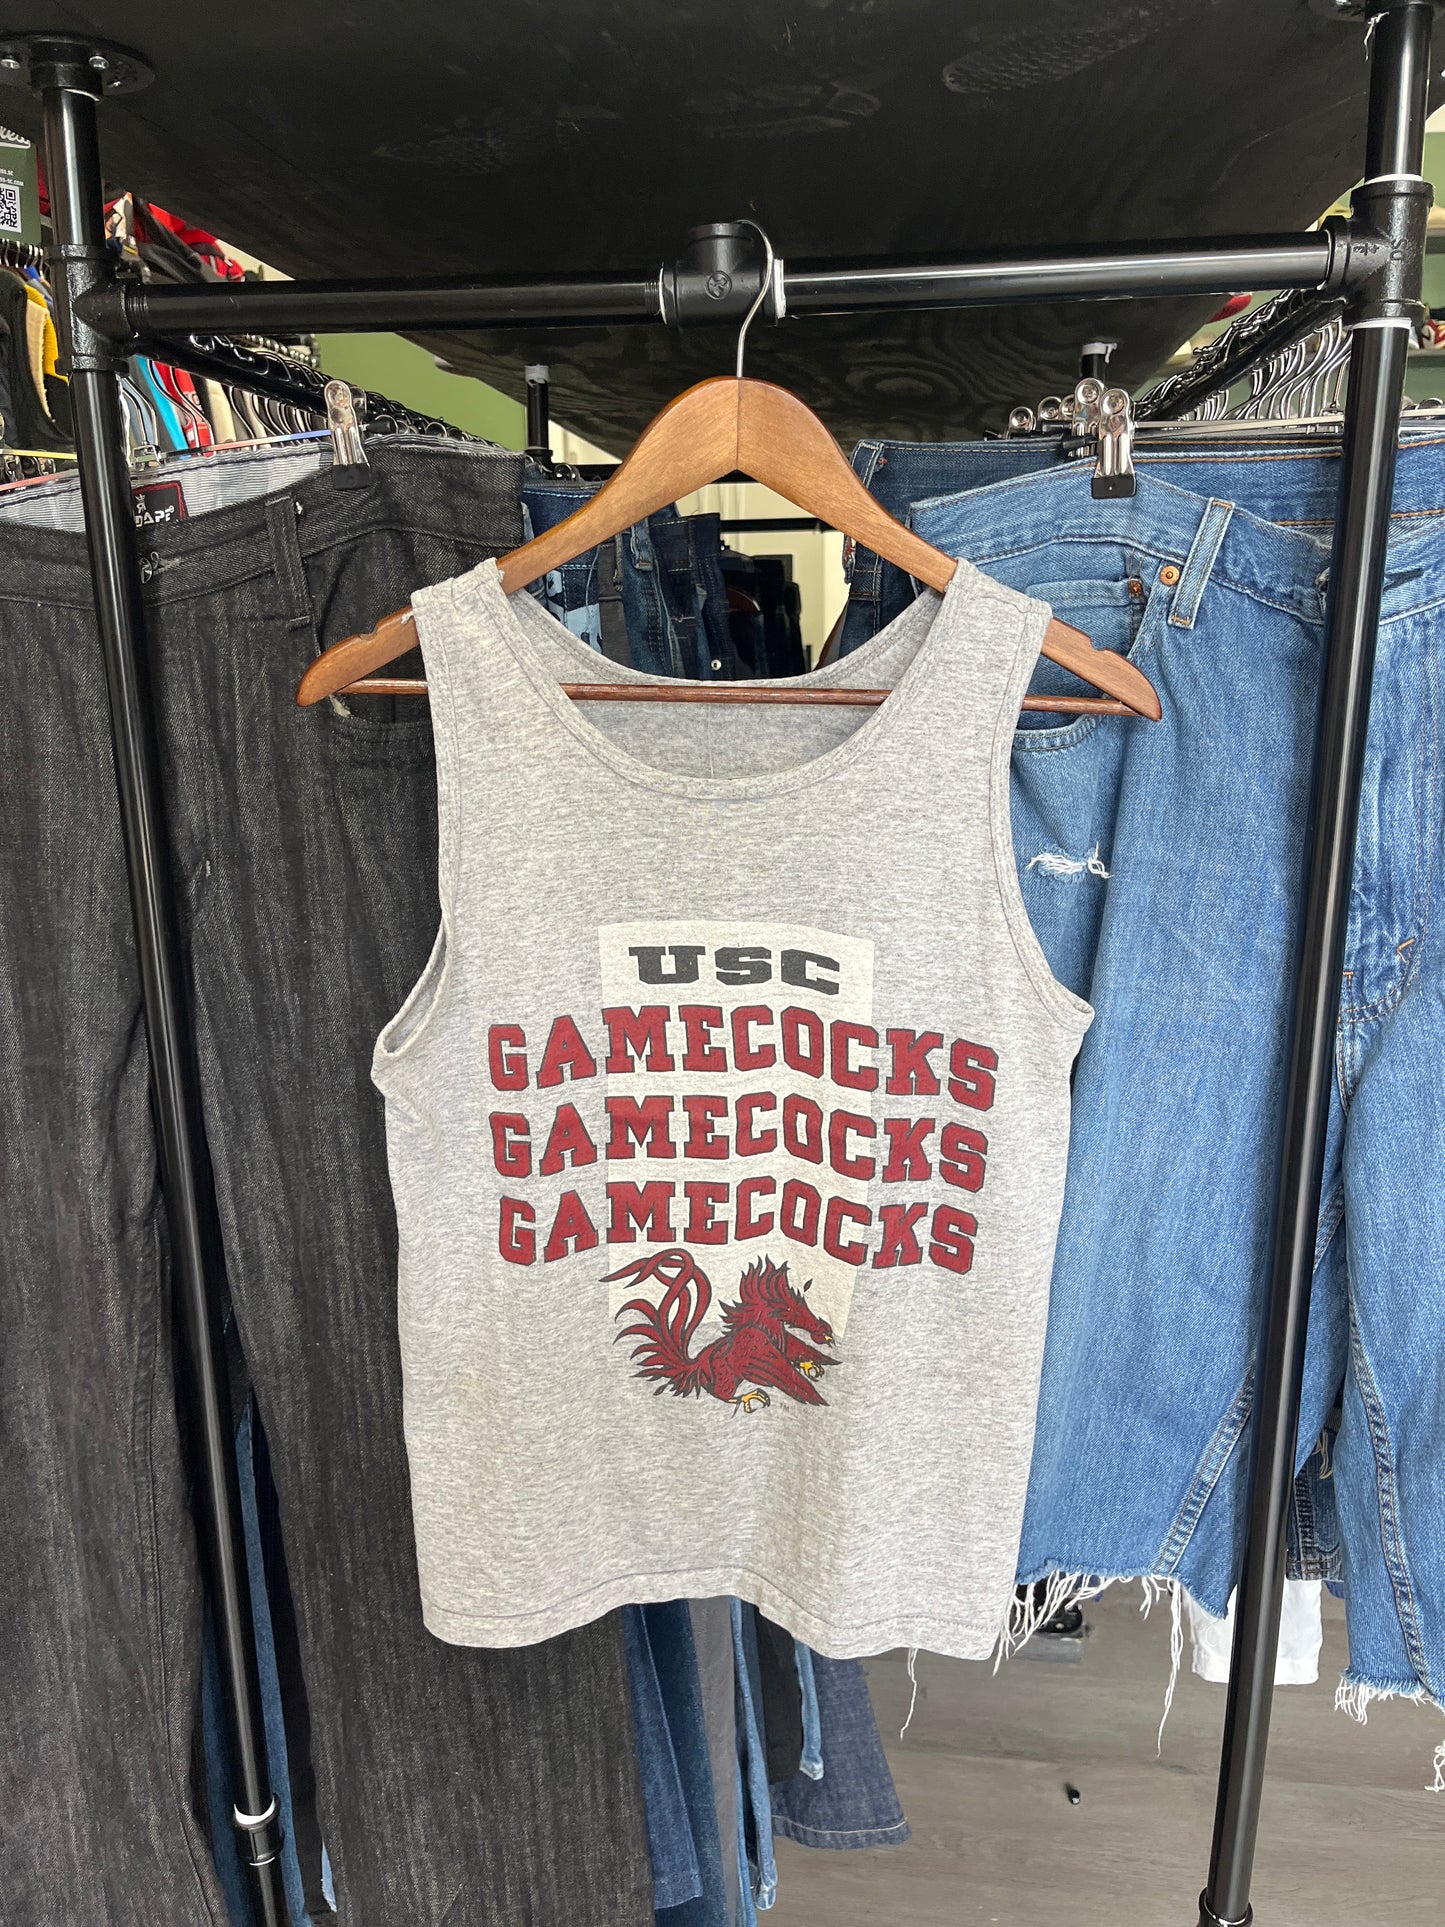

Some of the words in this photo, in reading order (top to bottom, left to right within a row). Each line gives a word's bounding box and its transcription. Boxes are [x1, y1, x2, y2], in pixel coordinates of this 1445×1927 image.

[628, 945, 840, 995] USC
[488, 1004, 999, 1111] GAMECOCKS
[488, 1091, 988, 1193] GAMECOCKS
[499, 1175, 979, 1275] GAMECOCKS
